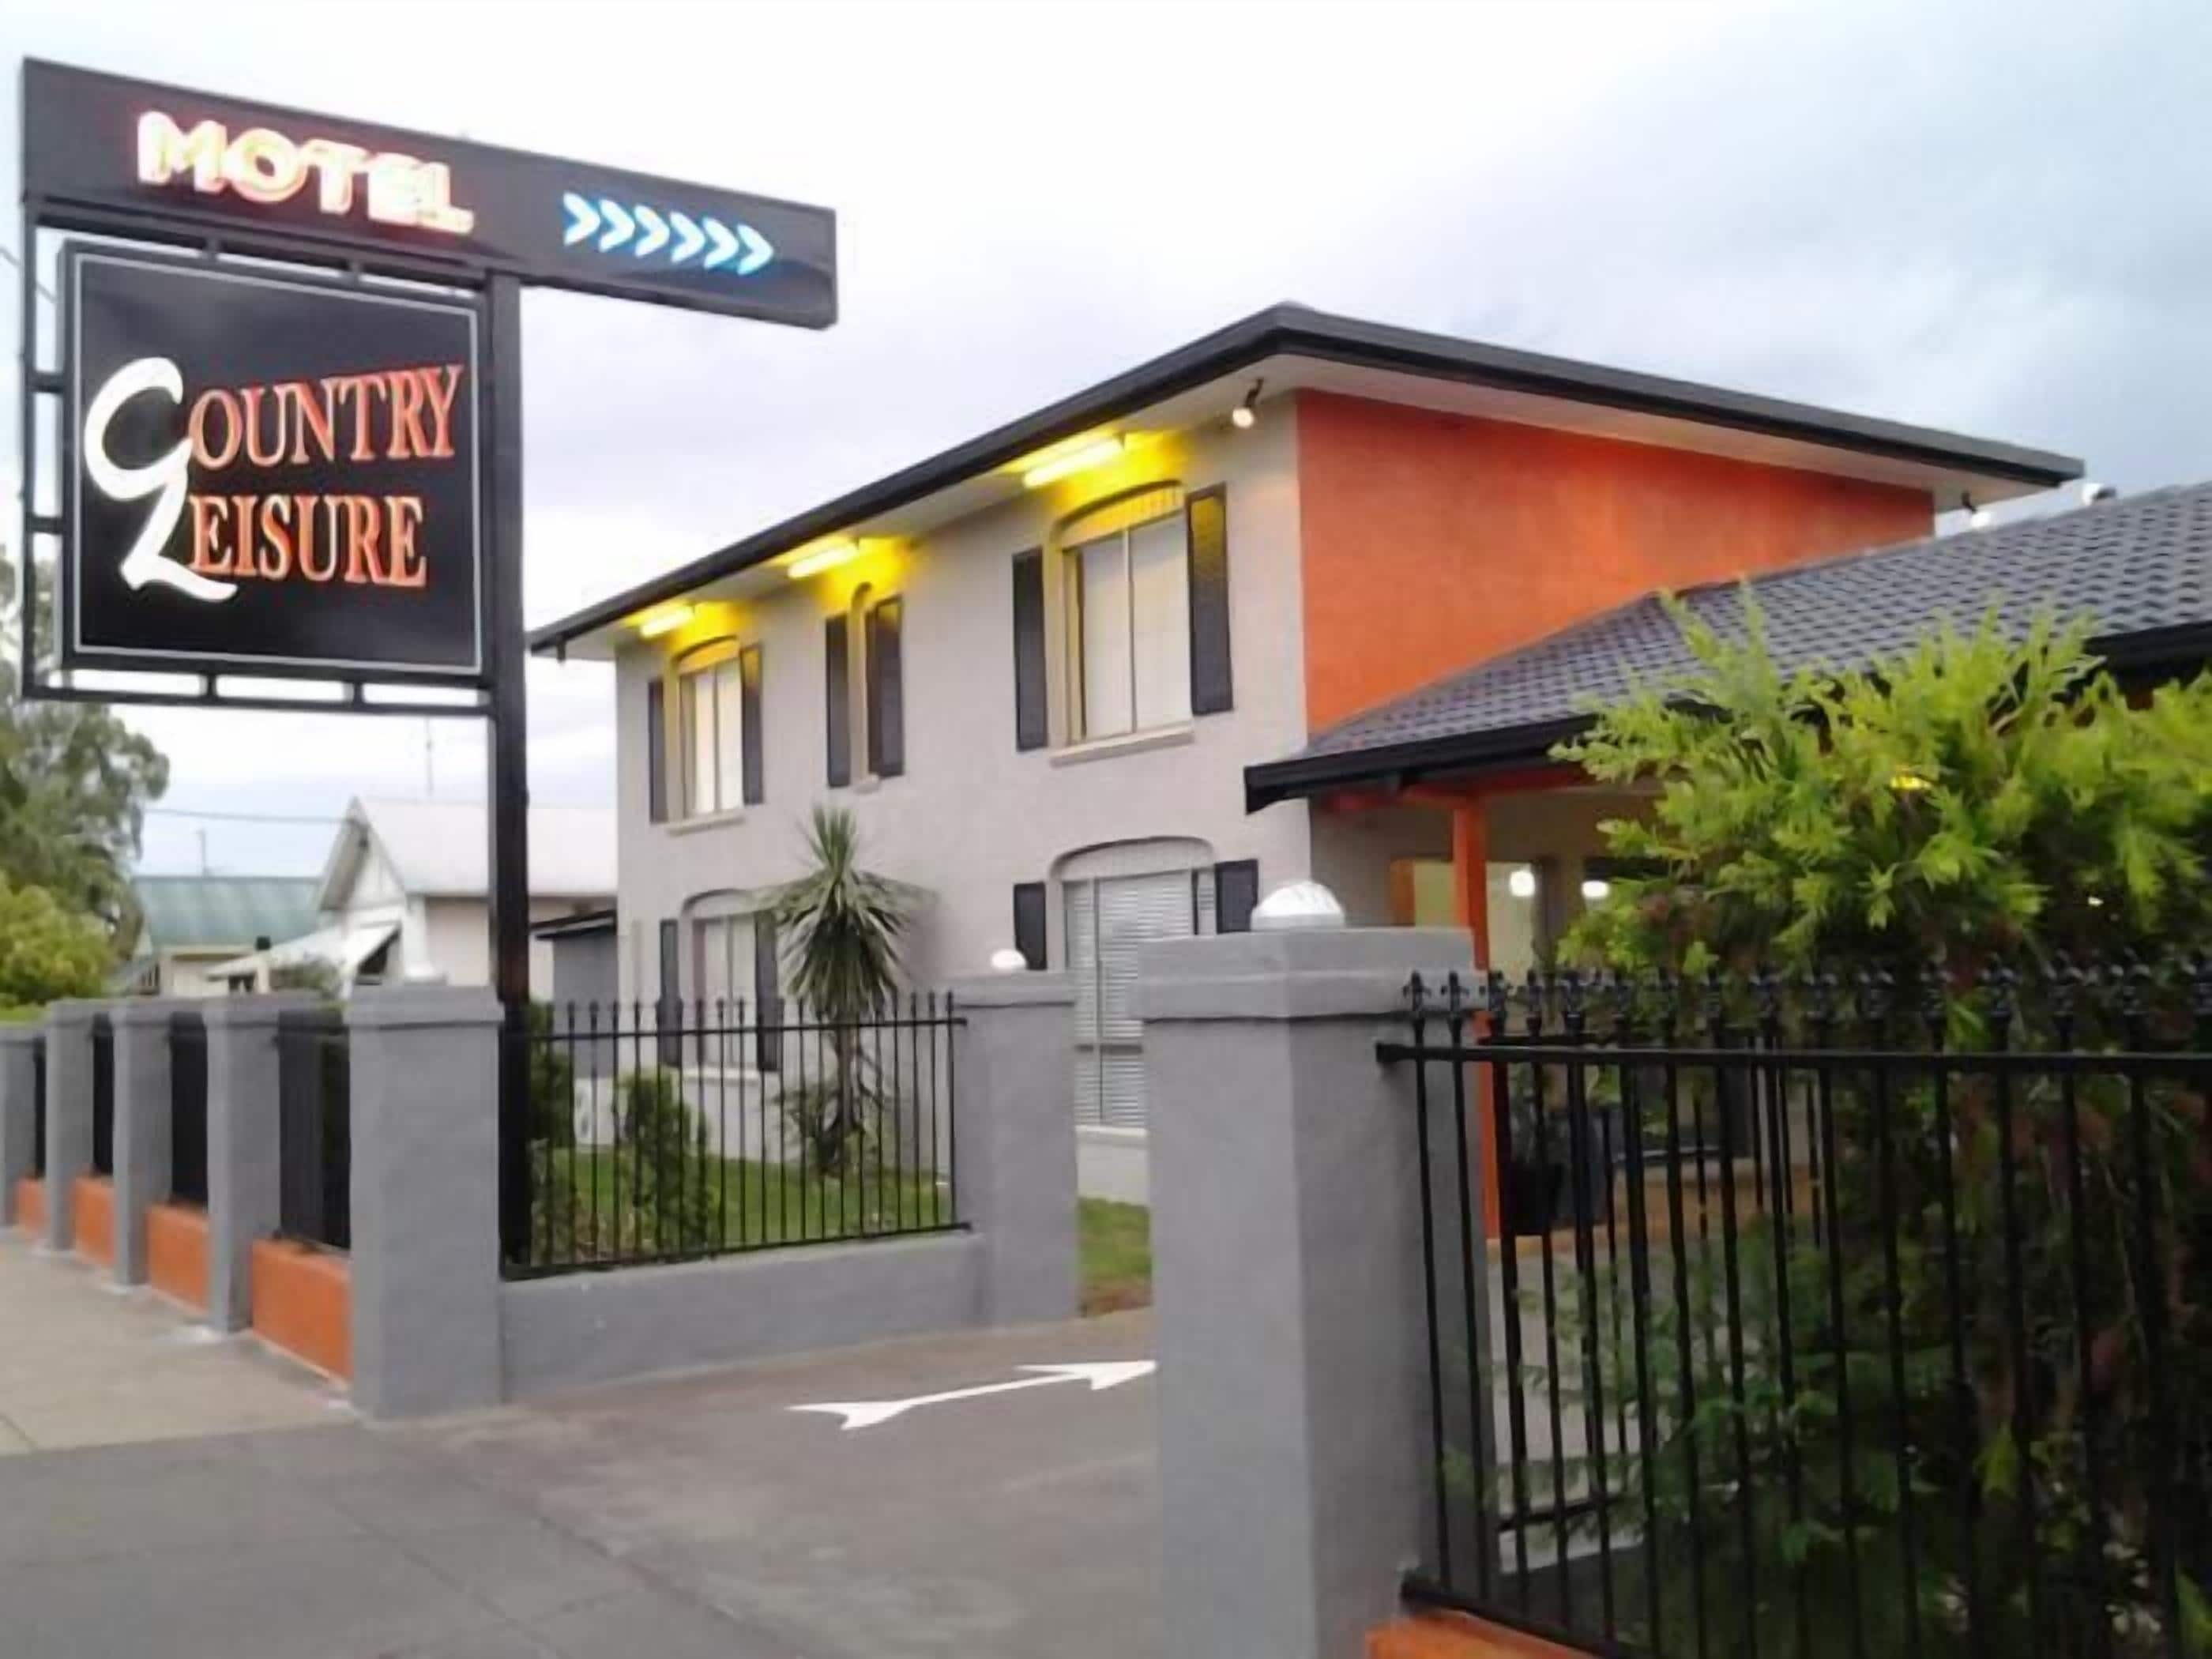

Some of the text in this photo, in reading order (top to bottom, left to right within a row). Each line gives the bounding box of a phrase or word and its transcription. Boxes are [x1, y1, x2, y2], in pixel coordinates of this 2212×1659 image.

[137, 111, 474, 234] MOTEL
[85, 357, 464, 501] COUNTRY
[120, 474, 427, 602] LEISURE
